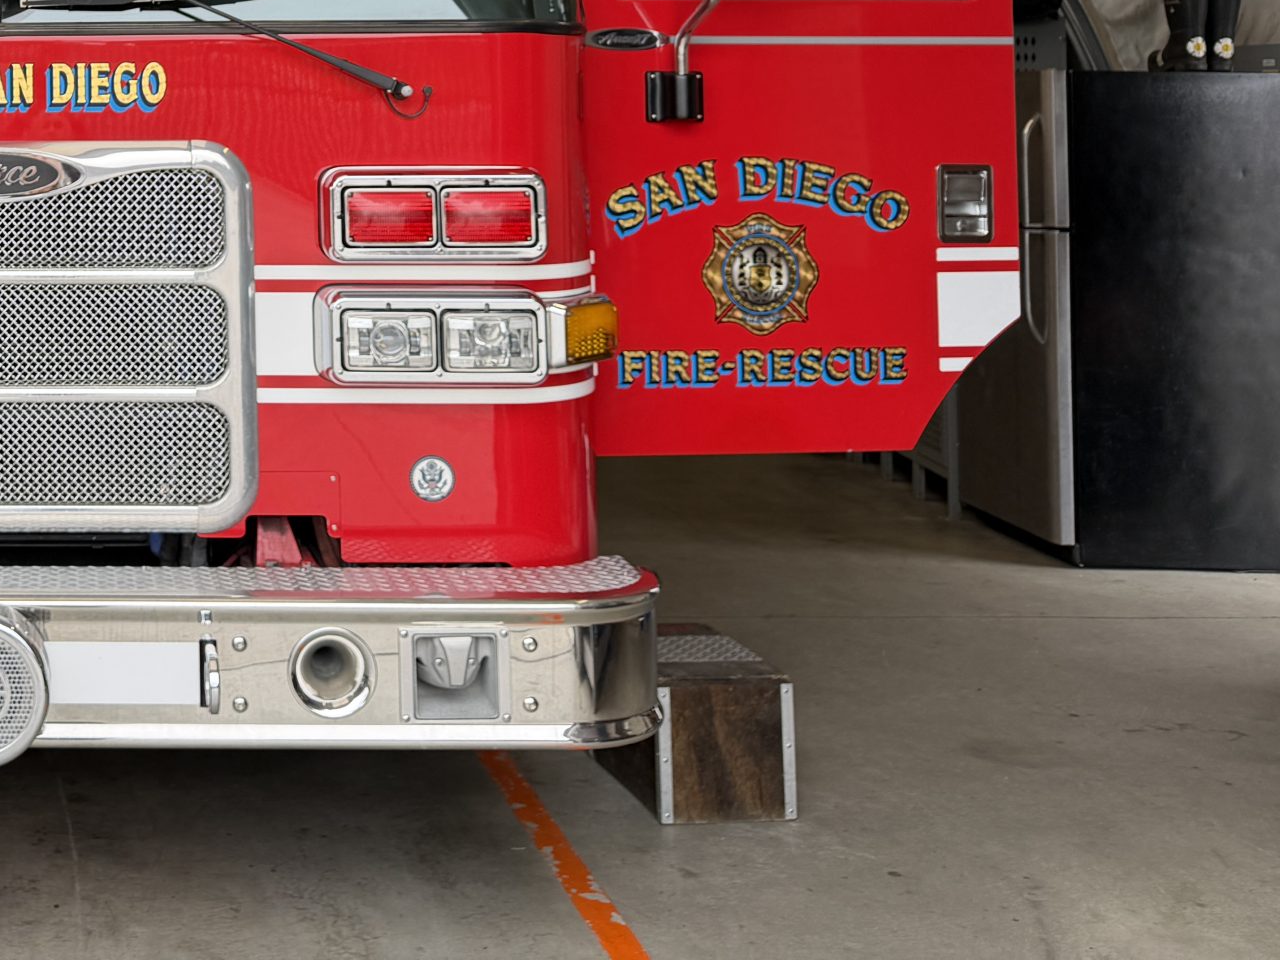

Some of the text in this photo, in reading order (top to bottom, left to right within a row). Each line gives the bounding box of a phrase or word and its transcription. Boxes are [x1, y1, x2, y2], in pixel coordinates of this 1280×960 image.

[45, 61, 168, 113] DIEGO
[605, 156, 911, 240] SAN DIEGO
[617, 347, 909, 389] FIRE-RESCUE
